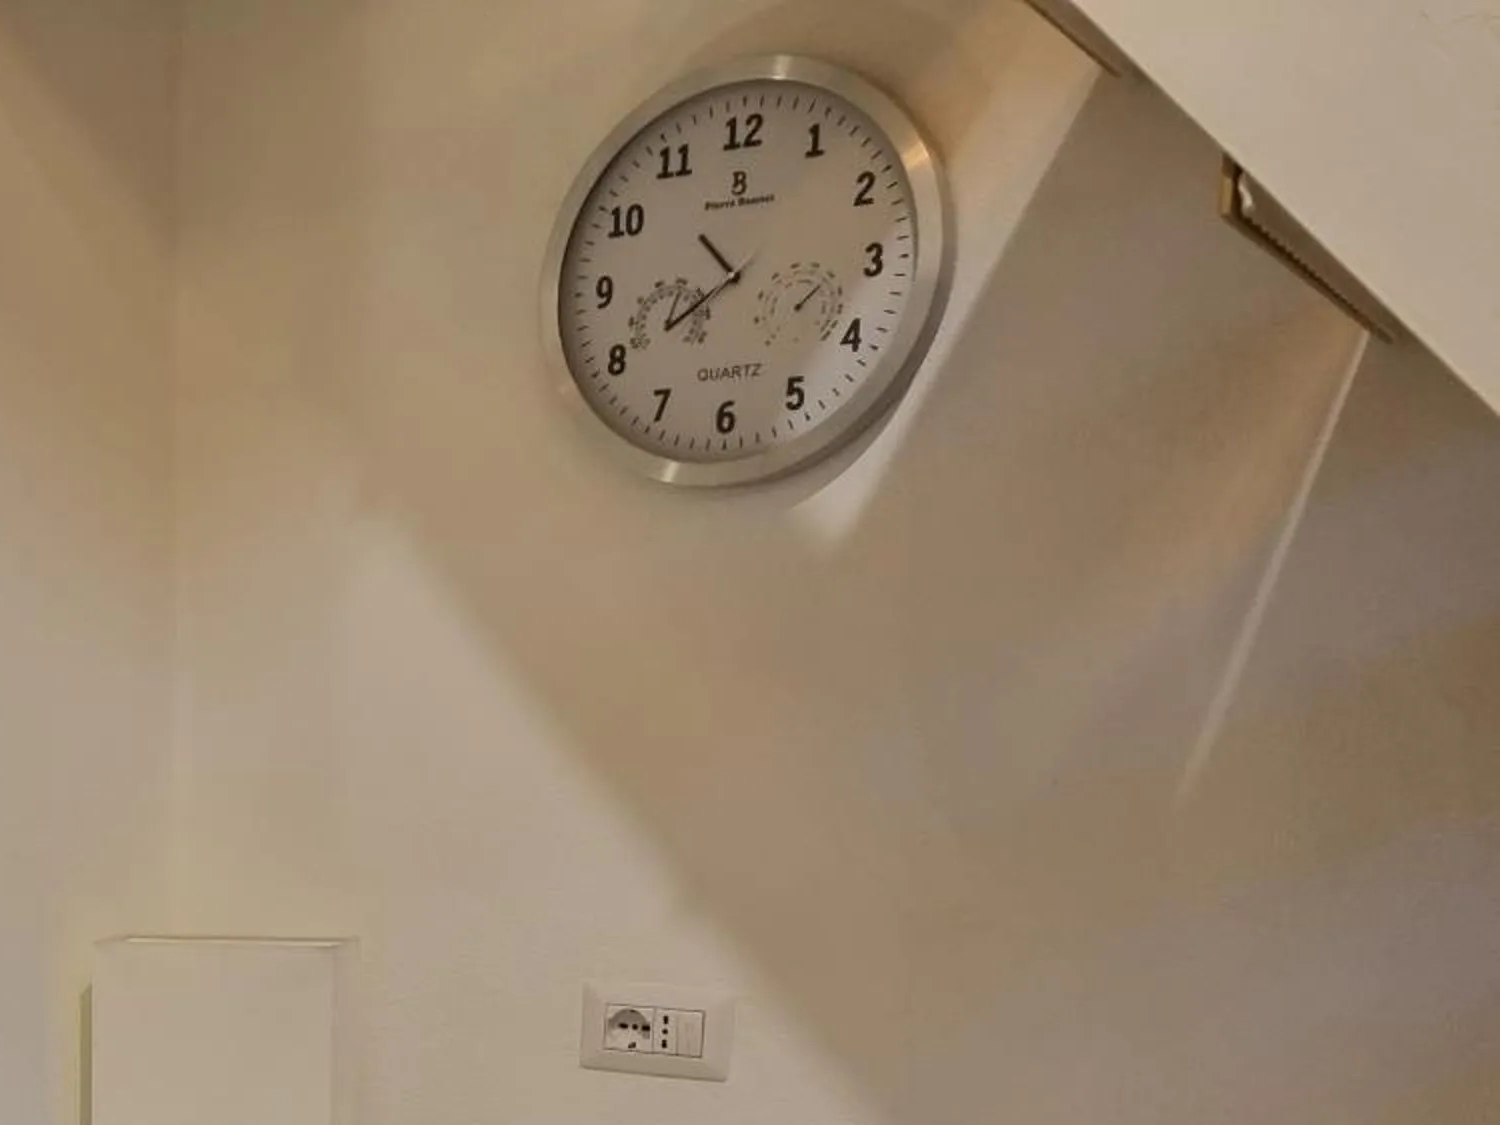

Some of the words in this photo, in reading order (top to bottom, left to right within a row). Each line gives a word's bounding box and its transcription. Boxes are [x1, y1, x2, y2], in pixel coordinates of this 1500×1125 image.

[722, 113, 764, 152] 12
[805, 123, 825, 159] 1
[656, 143, 693, 180] 11
[853, 170, 876, 207] 2
[607, 203, 645, 239] 10
[863, 241, 884, 278] 3
[595, 275, 614, 310] 9
[839, 317, 862, 353] 4
[607, 344, 627, 377] 8
[696, 362, 763, 382] QUARTZ
[653, 388, 672, 423] 7
[785, 375, 805, 411] 5
[715, 400, 736, 435] 6
